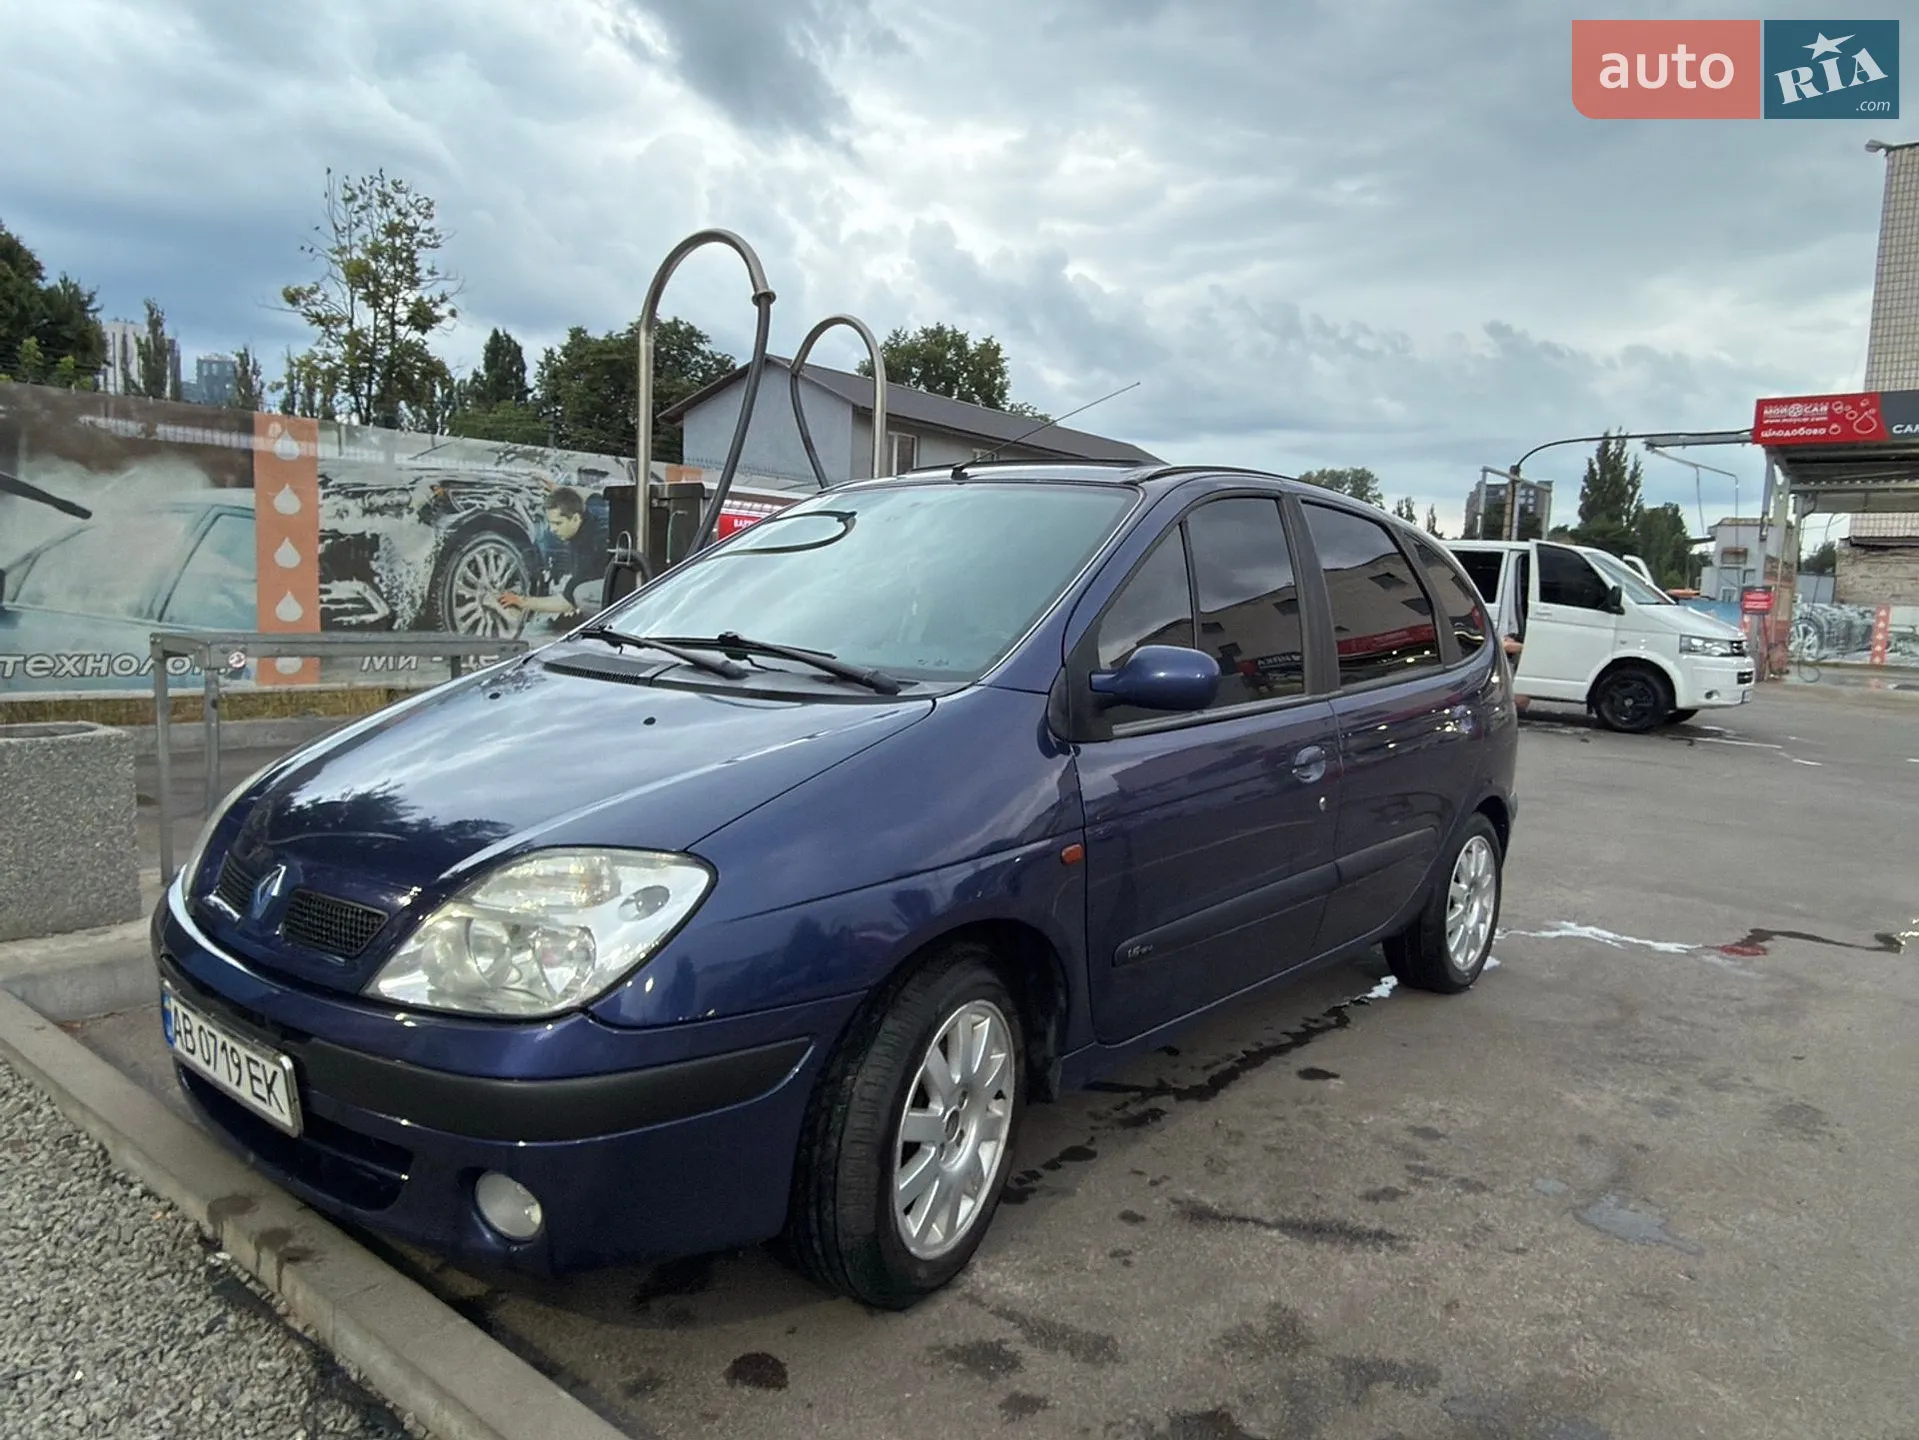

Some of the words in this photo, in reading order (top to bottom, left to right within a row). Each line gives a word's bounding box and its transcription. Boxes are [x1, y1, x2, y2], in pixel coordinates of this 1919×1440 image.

[173, 1004, 196, 1056] AB
[198, 1023, 243, 1088] 0719
[245, 1053, 286, 1116] EK
